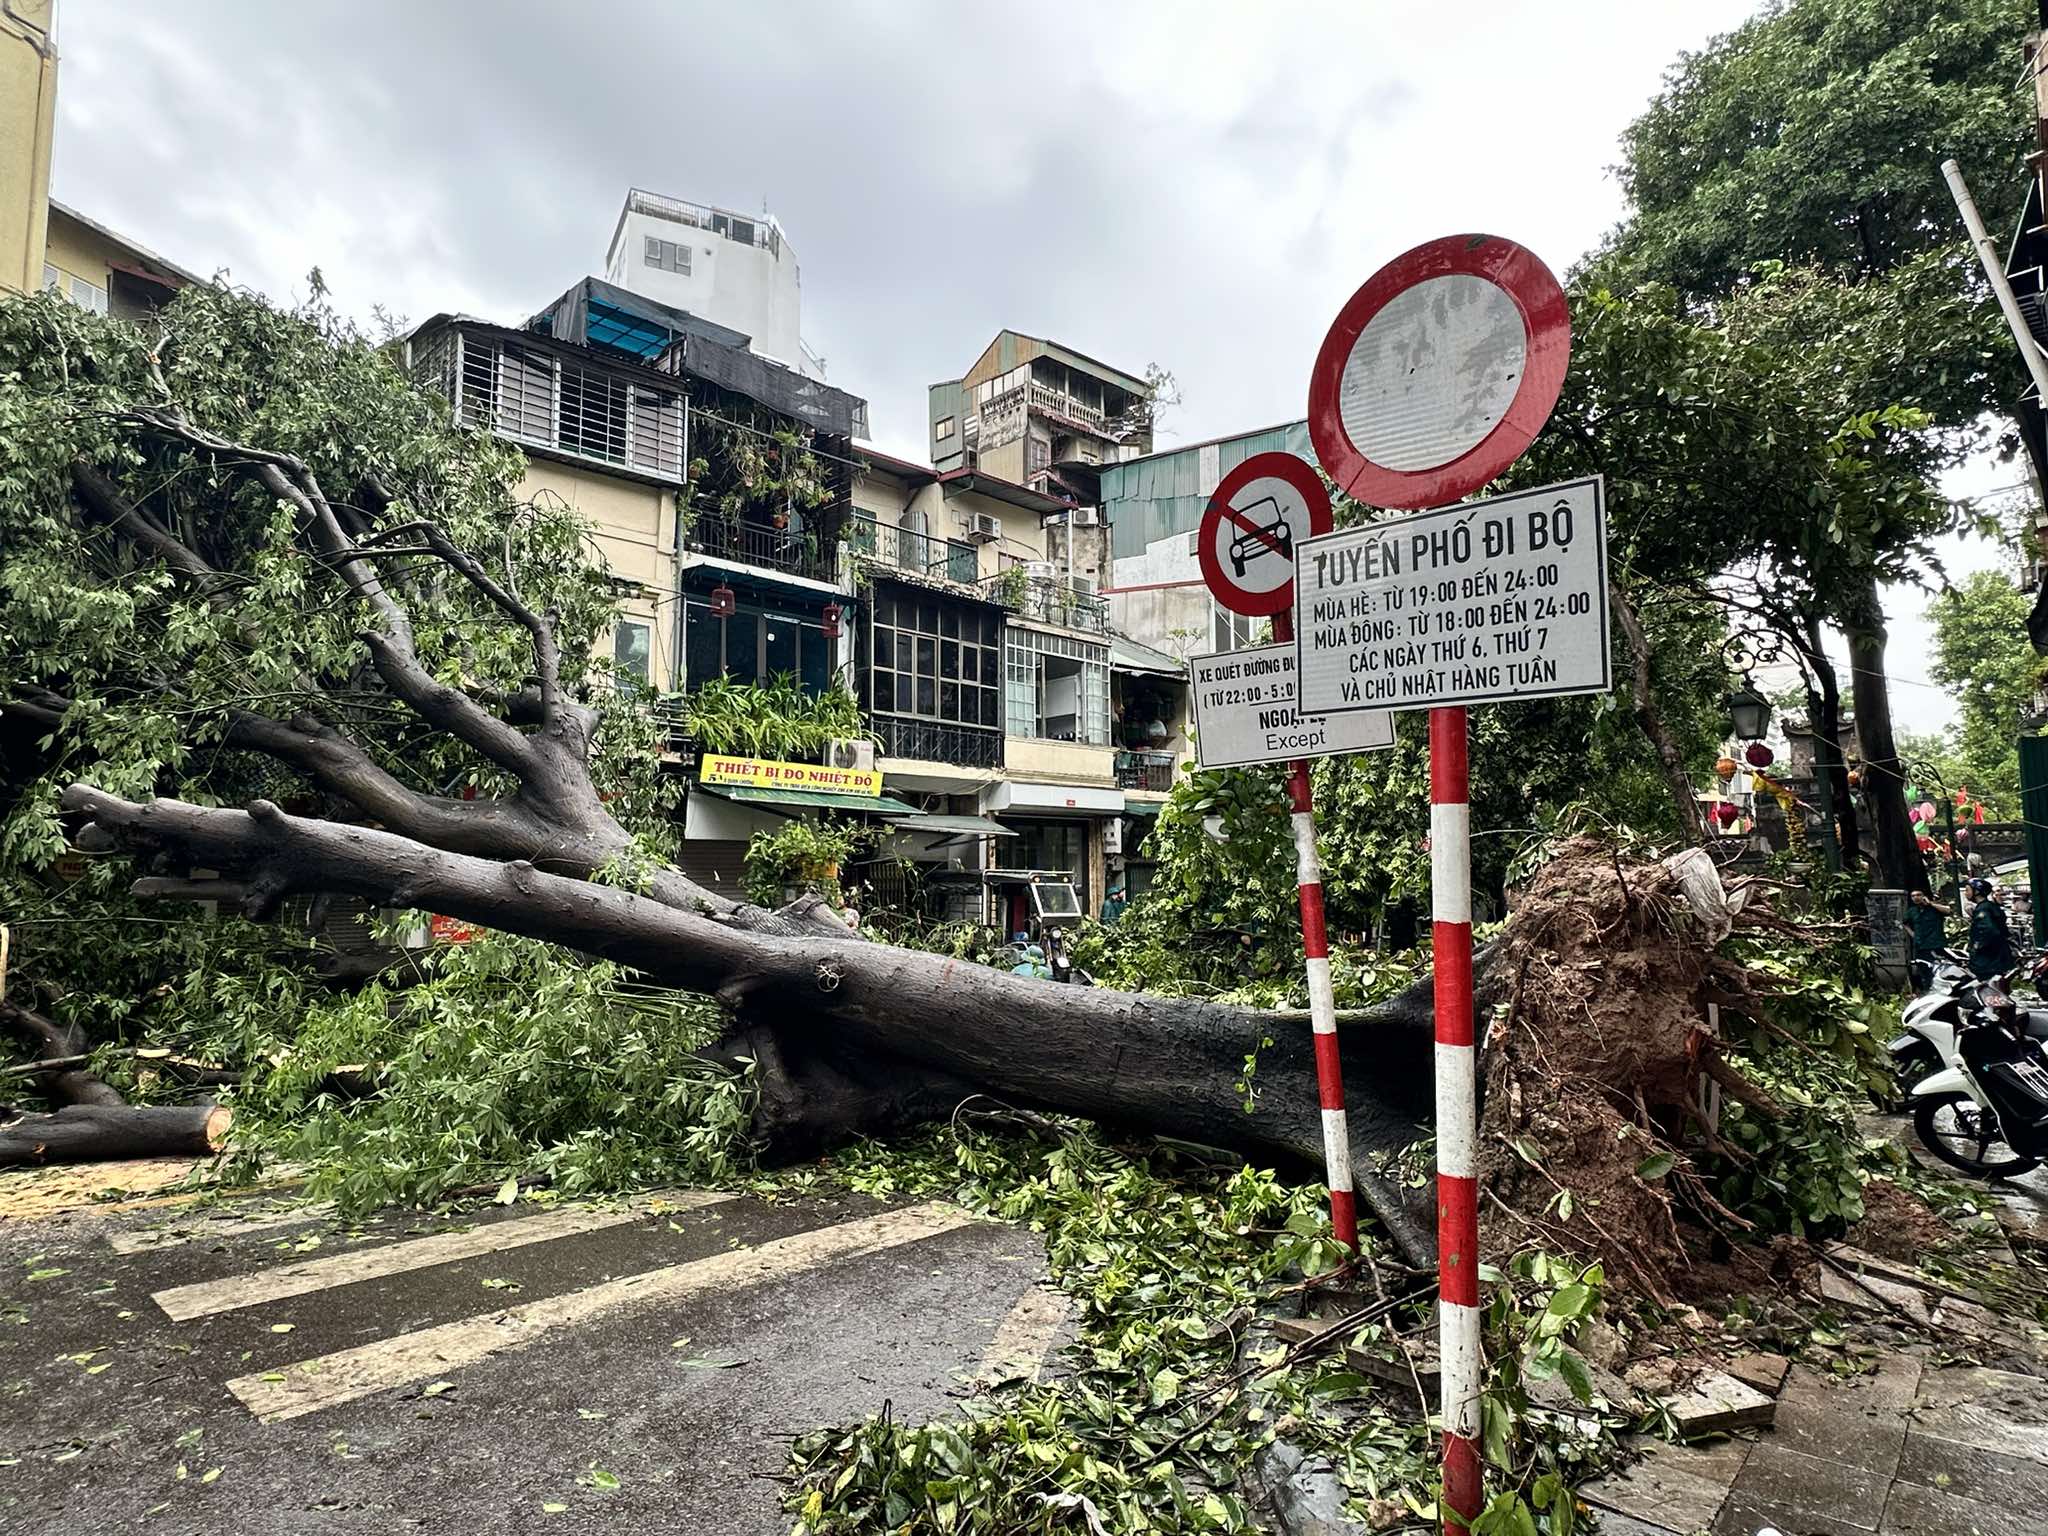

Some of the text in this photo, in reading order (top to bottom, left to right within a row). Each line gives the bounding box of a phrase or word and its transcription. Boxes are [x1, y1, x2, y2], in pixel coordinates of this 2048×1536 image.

[1312, 499, 1574, 589] TUYẾN PHỐ ĐI BỘ
[1313, 564, 1558, 623] MÙA HÈ: TỪ 19:00 ĐẾN 24:00
[1314, 592, 1590, 650] MÙA ĐÔNG: TỪ 18:00 ĐẾN 24:00
[1349, 646, 1379, 673] CÁC
[1384, 638, 1426, 669] NGÀY
[1431, 636, 1465, 662] THỨ
[1494, 625, 1532, 656] THỨ
[1537, 628, 1548, 650] 7
[1199, 668, 1212, 683] XE
[1215, 661, 1241, 681] QUÉT
[1244, 656, 1280, 677] ĐƯỜNG
[1341, 655, 1557, 702] VÀ CHỦ NHẬT HÀNG TUẦN
[1226, 687, 1261, 705] 22:00
[1271, 682, 1295, 699] 5:0
[1259, 708, 1305, 730] NGOẠ
[1266, 729, 1326, 751] Except
[714, 759, 761, 776] THIẾT
[765, 766, 780, 782] BỊ
[784, 769, 805, 780] ĐO
[808, 770, 852, 787] NHIỆT
[854, 771, 873, 789] ĐỘ
